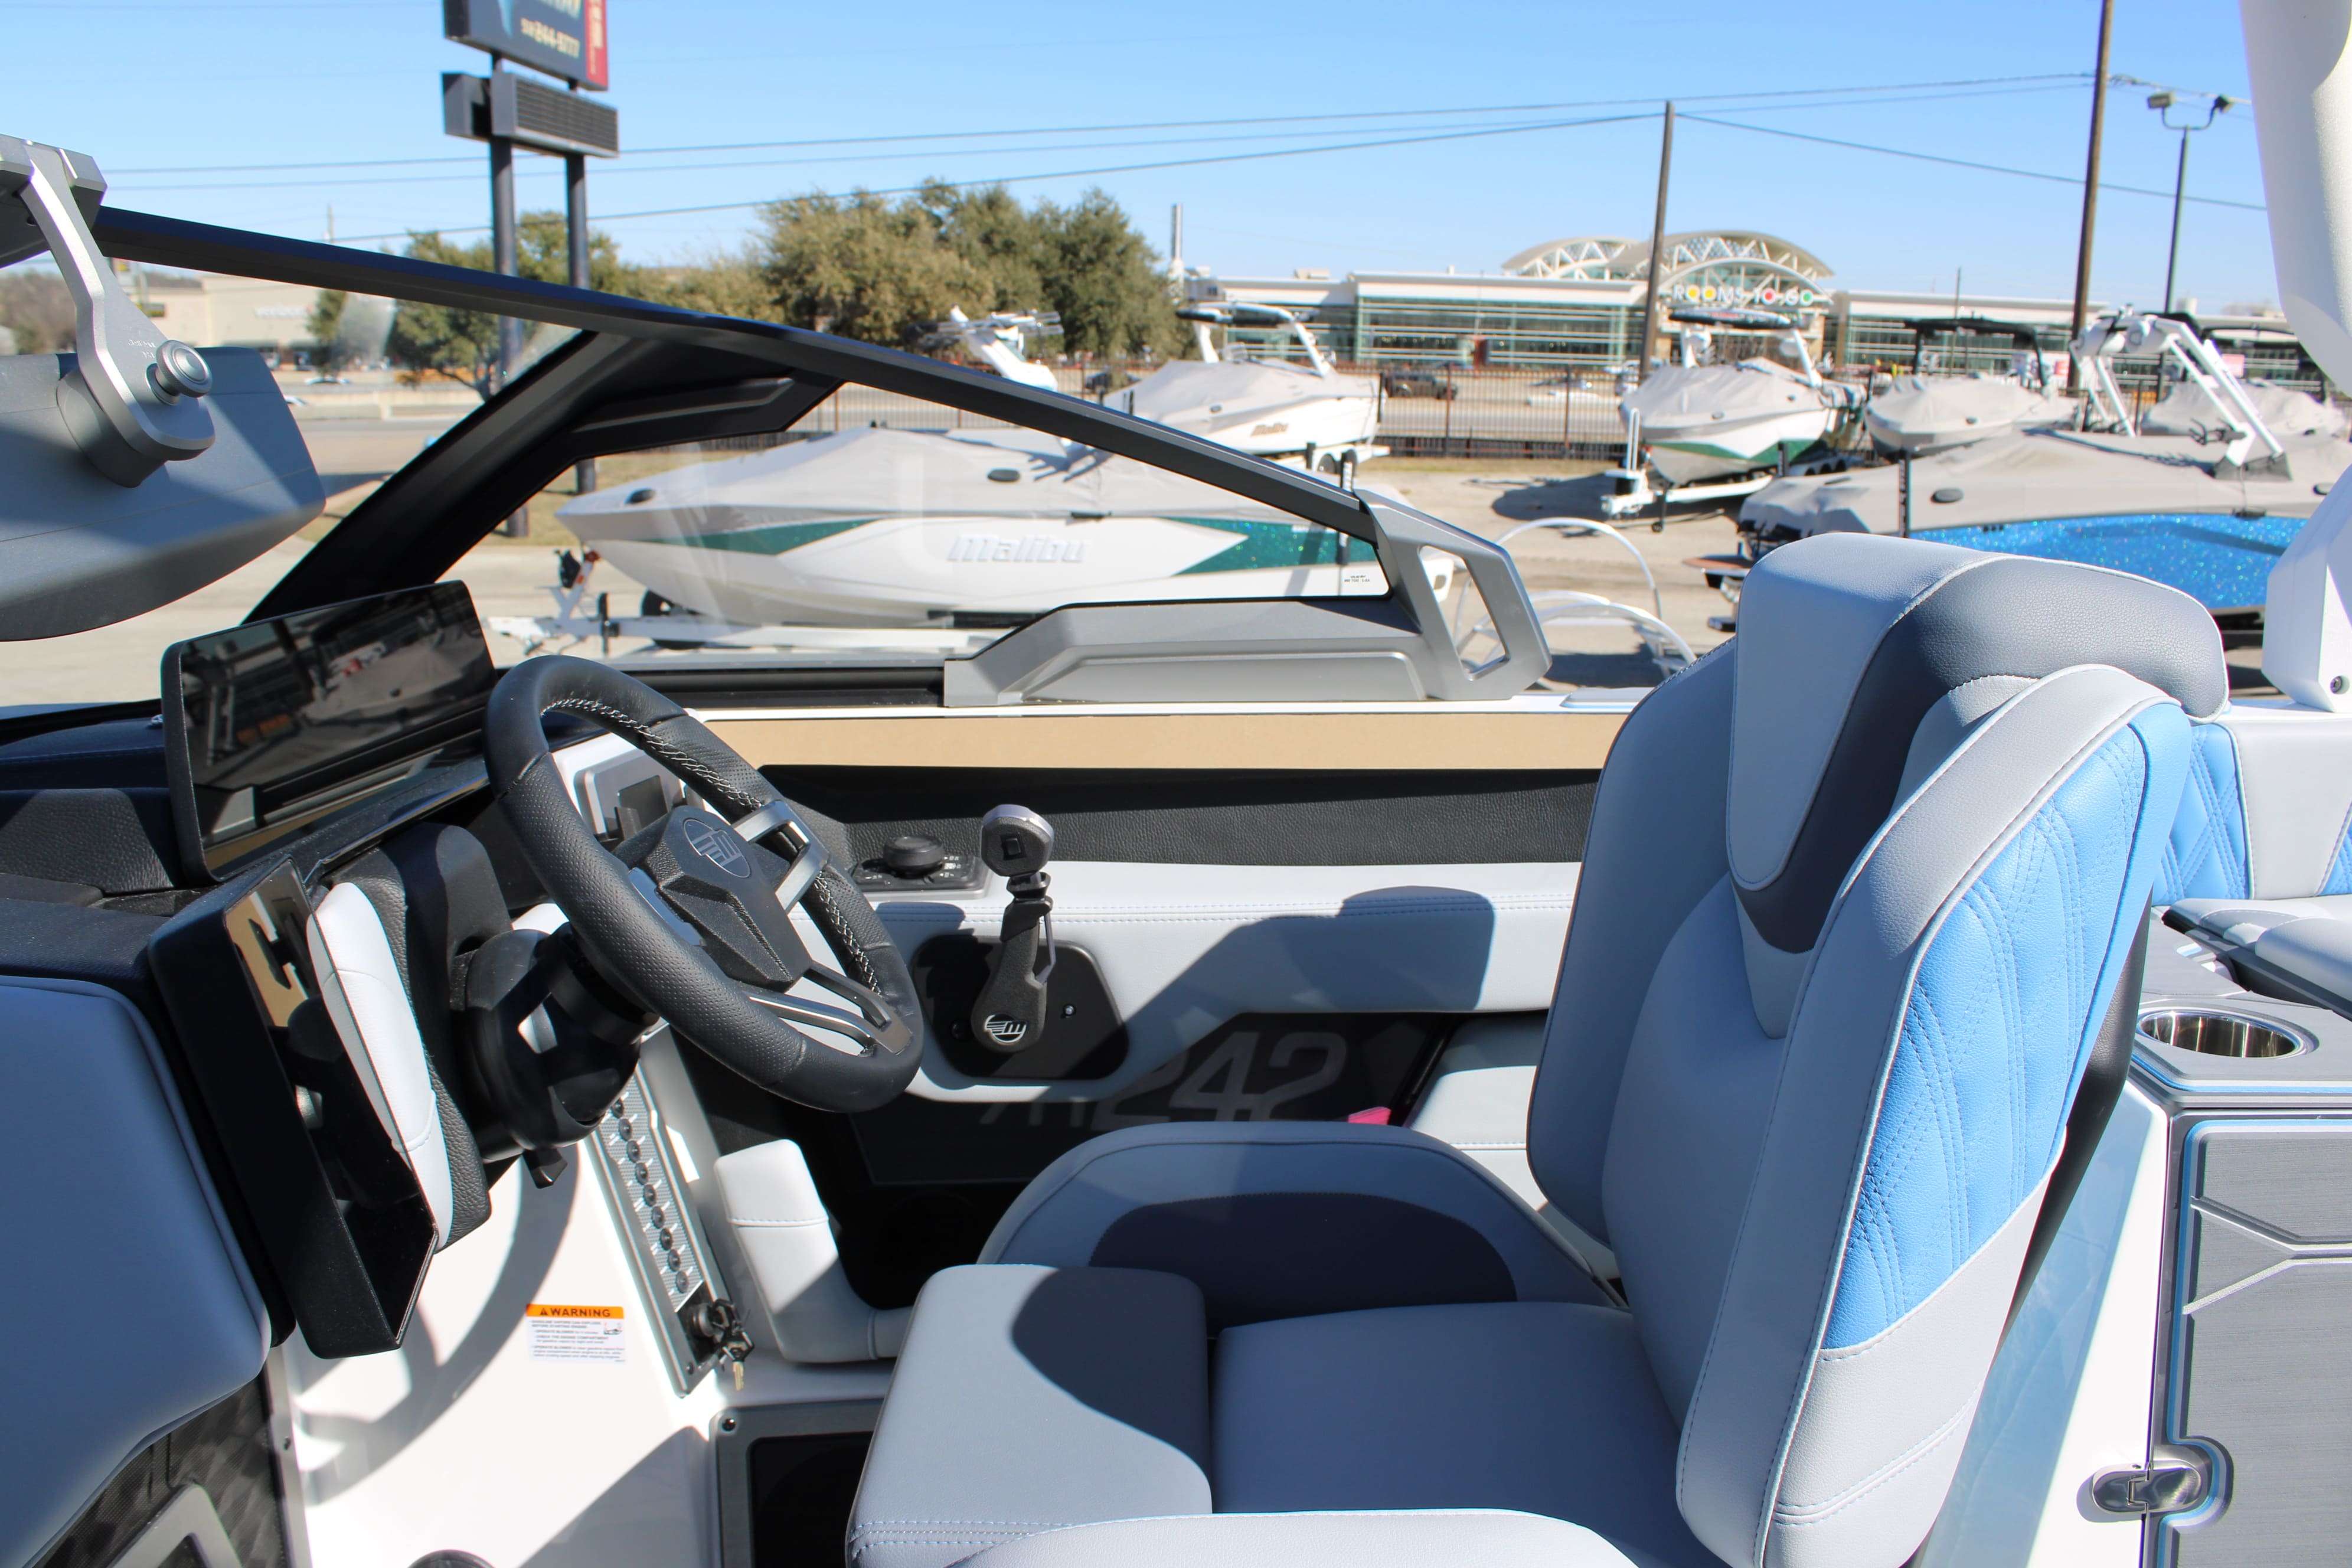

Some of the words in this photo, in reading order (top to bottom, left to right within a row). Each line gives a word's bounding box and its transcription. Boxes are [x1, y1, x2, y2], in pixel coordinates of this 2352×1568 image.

[1672, 283, 1745, 303] ROOMS
[1752, 287, 1776, 306] TO
[1784, 289, 1814, 306] GO
[550, 1307, 611, 1318] WARNING
